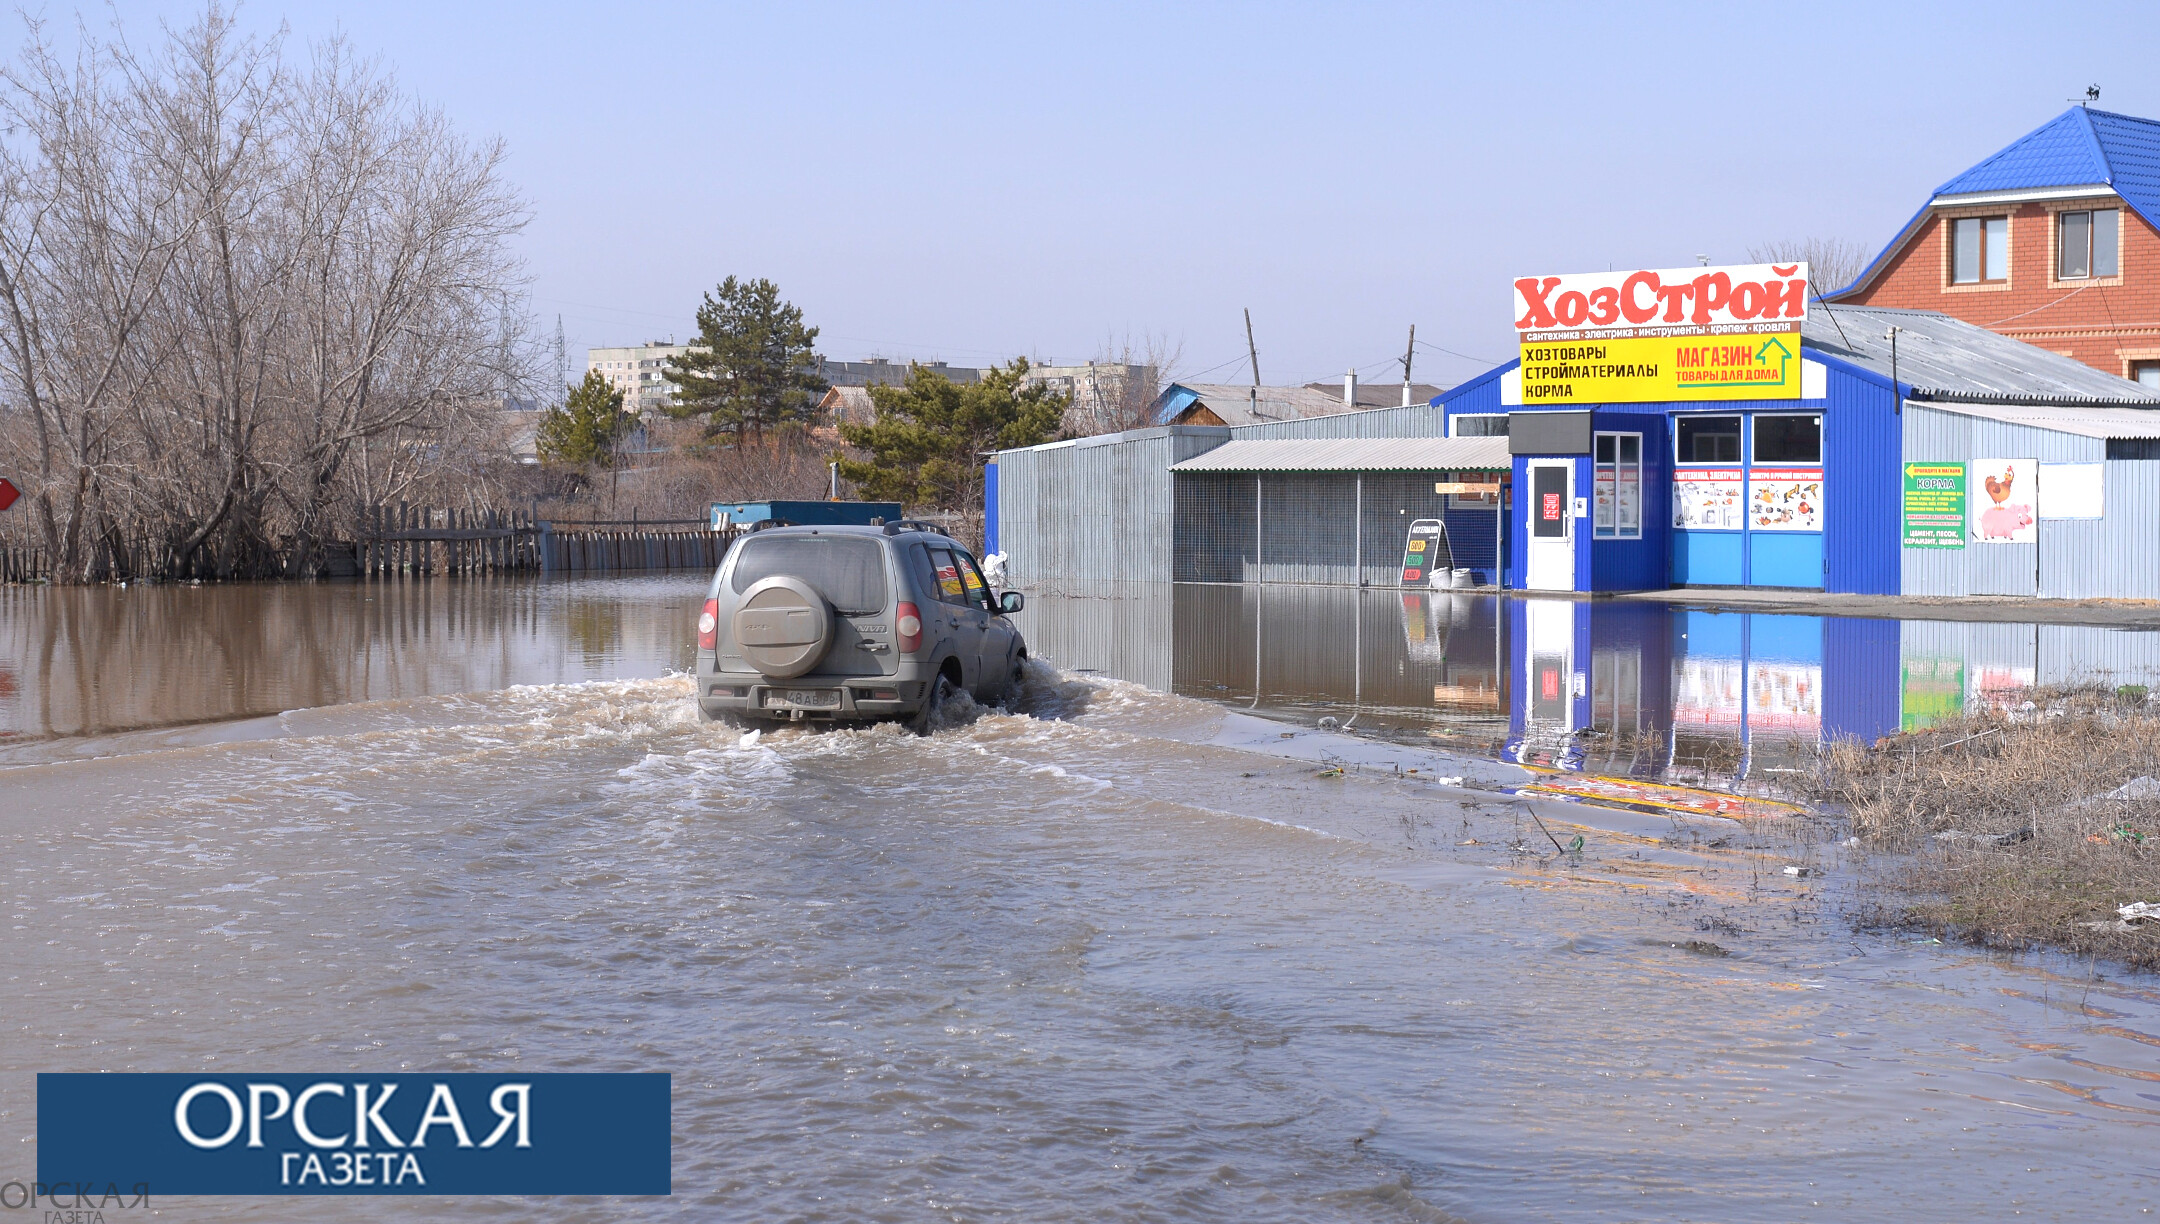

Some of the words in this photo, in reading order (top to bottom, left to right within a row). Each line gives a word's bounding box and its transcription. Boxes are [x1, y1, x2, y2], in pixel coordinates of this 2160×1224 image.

[1515, 265, 1807, 329] ХозСтрой
[1526, 331, 1580, 341] сантехника
[1584, 328, 1634, 340] электрика
[1638, 326, 1706, 337] инструменты
[1710, 324, 1748, 335] крепеж
[1753, 322, 1791, 334] кровля
[1525, 346, 1606, 361] ХОЗТОВАРЫ
[1676, 345, 1752, 368] МАГАЗИН
[1525, 362, 1658, 379] СТРОЙМАТЕРИАЛЫ
[1676, 370, 1719, 381] ТОВАРЫ
[1720, 369, 1743, 381] ДЛЯ
[1745, 369, 1779, 381] ДОМА
[1525, 384, 1573, 397] КОРМА
[1917, 478, 1955, 489] КОРМА
